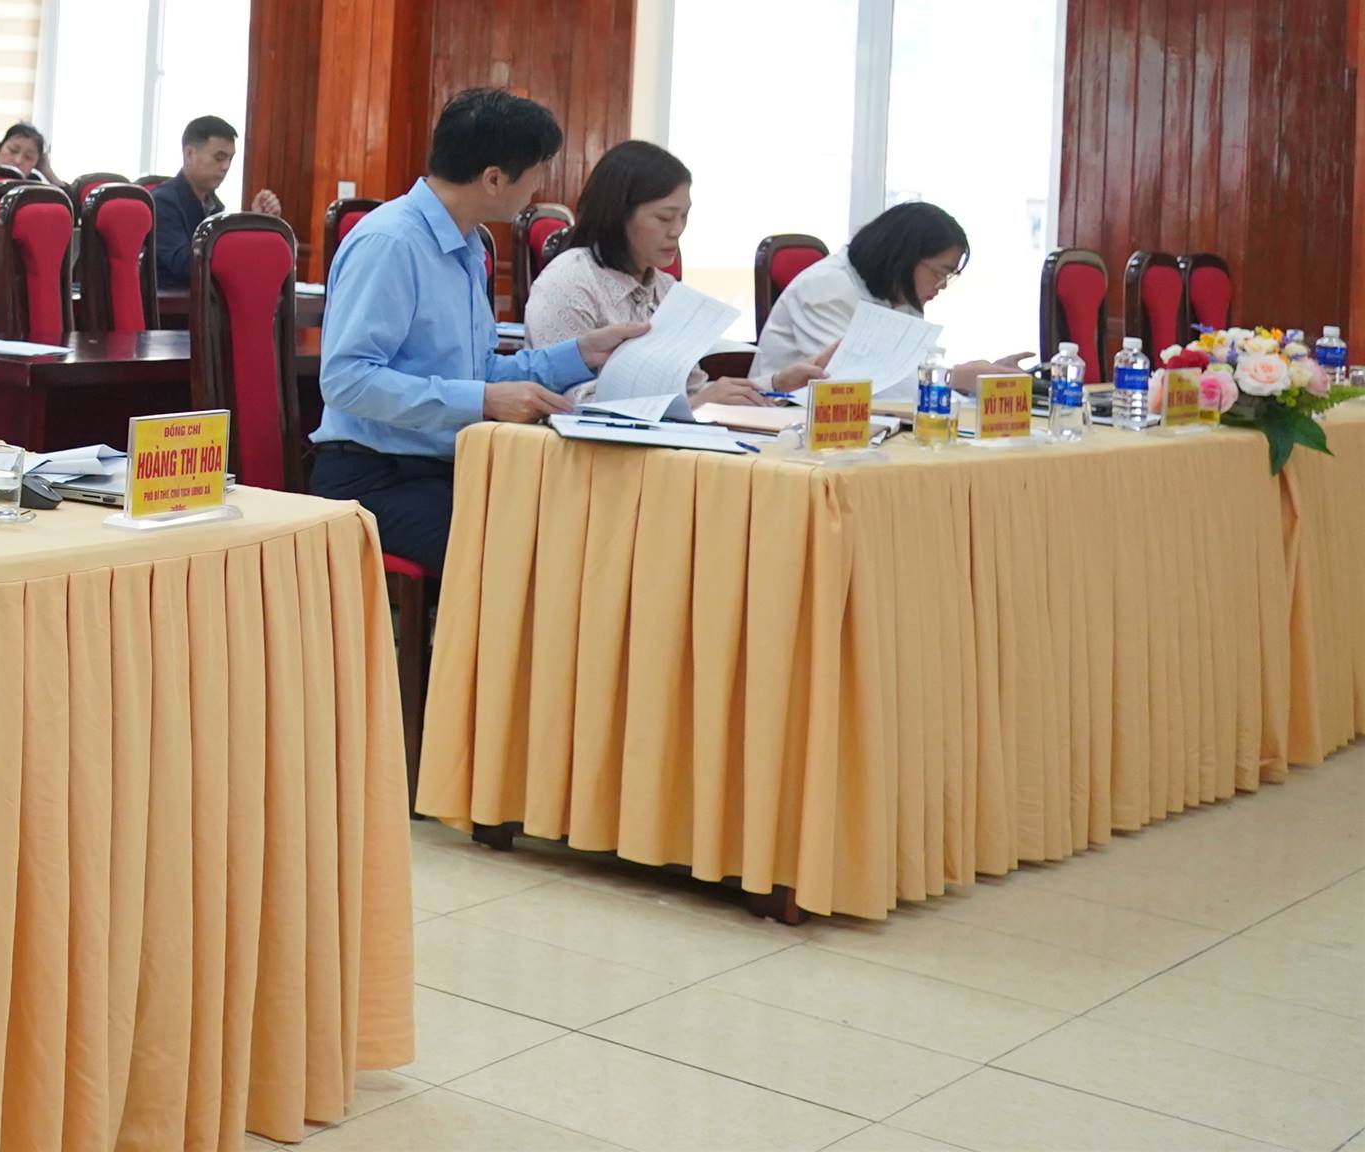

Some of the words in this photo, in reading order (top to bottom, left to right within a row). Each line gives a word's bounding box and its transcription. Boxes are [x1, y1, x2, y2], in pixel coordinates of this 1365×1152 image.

[164, 423, 186, 437] ĐỒNG
[188, 423, 201, 435] CHÍ
[137, 445, 178, 480] HOÀNG
[181, 448, 197, 480] THỊ
[200, 440, 222, 473] HÒA
